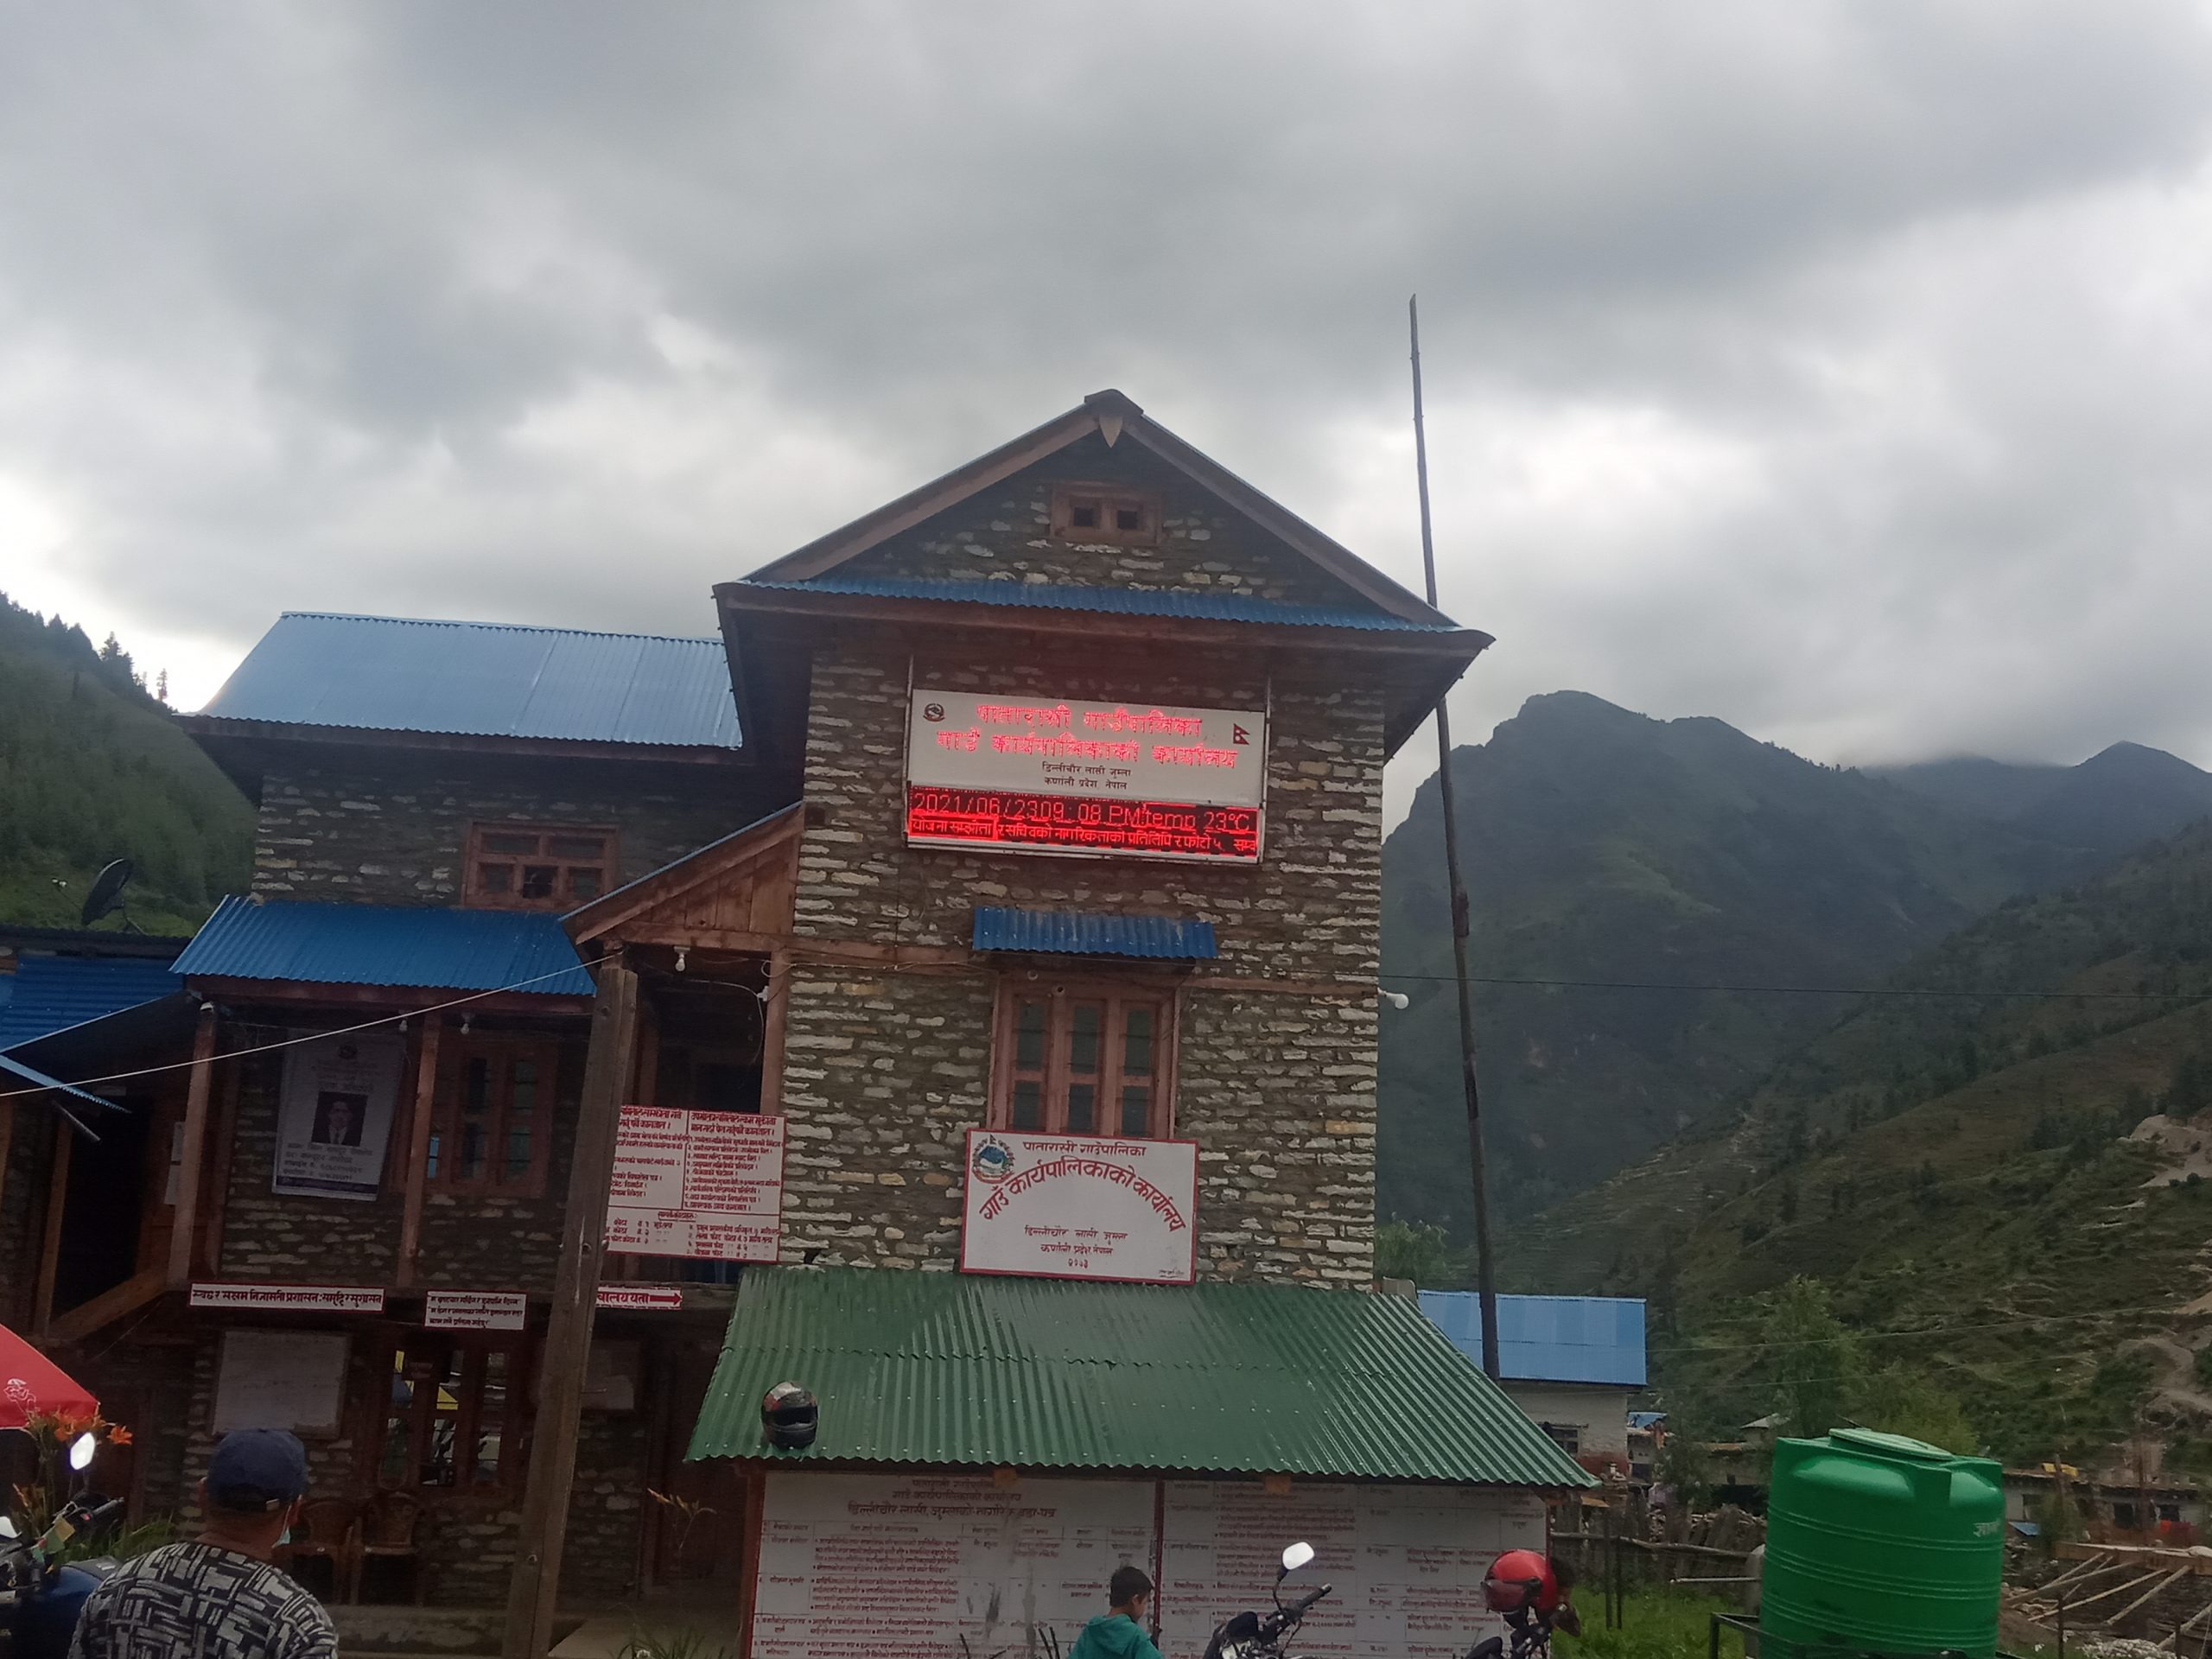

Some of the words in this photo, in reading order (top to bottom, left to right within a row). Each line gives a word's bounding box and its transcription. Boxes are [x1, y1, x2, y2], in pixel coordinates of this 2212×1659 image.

[1152, 741, 1238, 768] कार्यालय
[1079, 778, 1098, 788] प्रदेश
[1105, 779, 1128, 790] नेपाल
[912, 817, 947, 832] योजना
[1080, 1141, 1147, 1157] गाउँपालिका
[979, 1185, 1009, 1220] गाउँ
[1006, 1155, 1136, 1195] कार्यपालिकाको
[1133, 1177, 1186, 1232] कार्यालय
